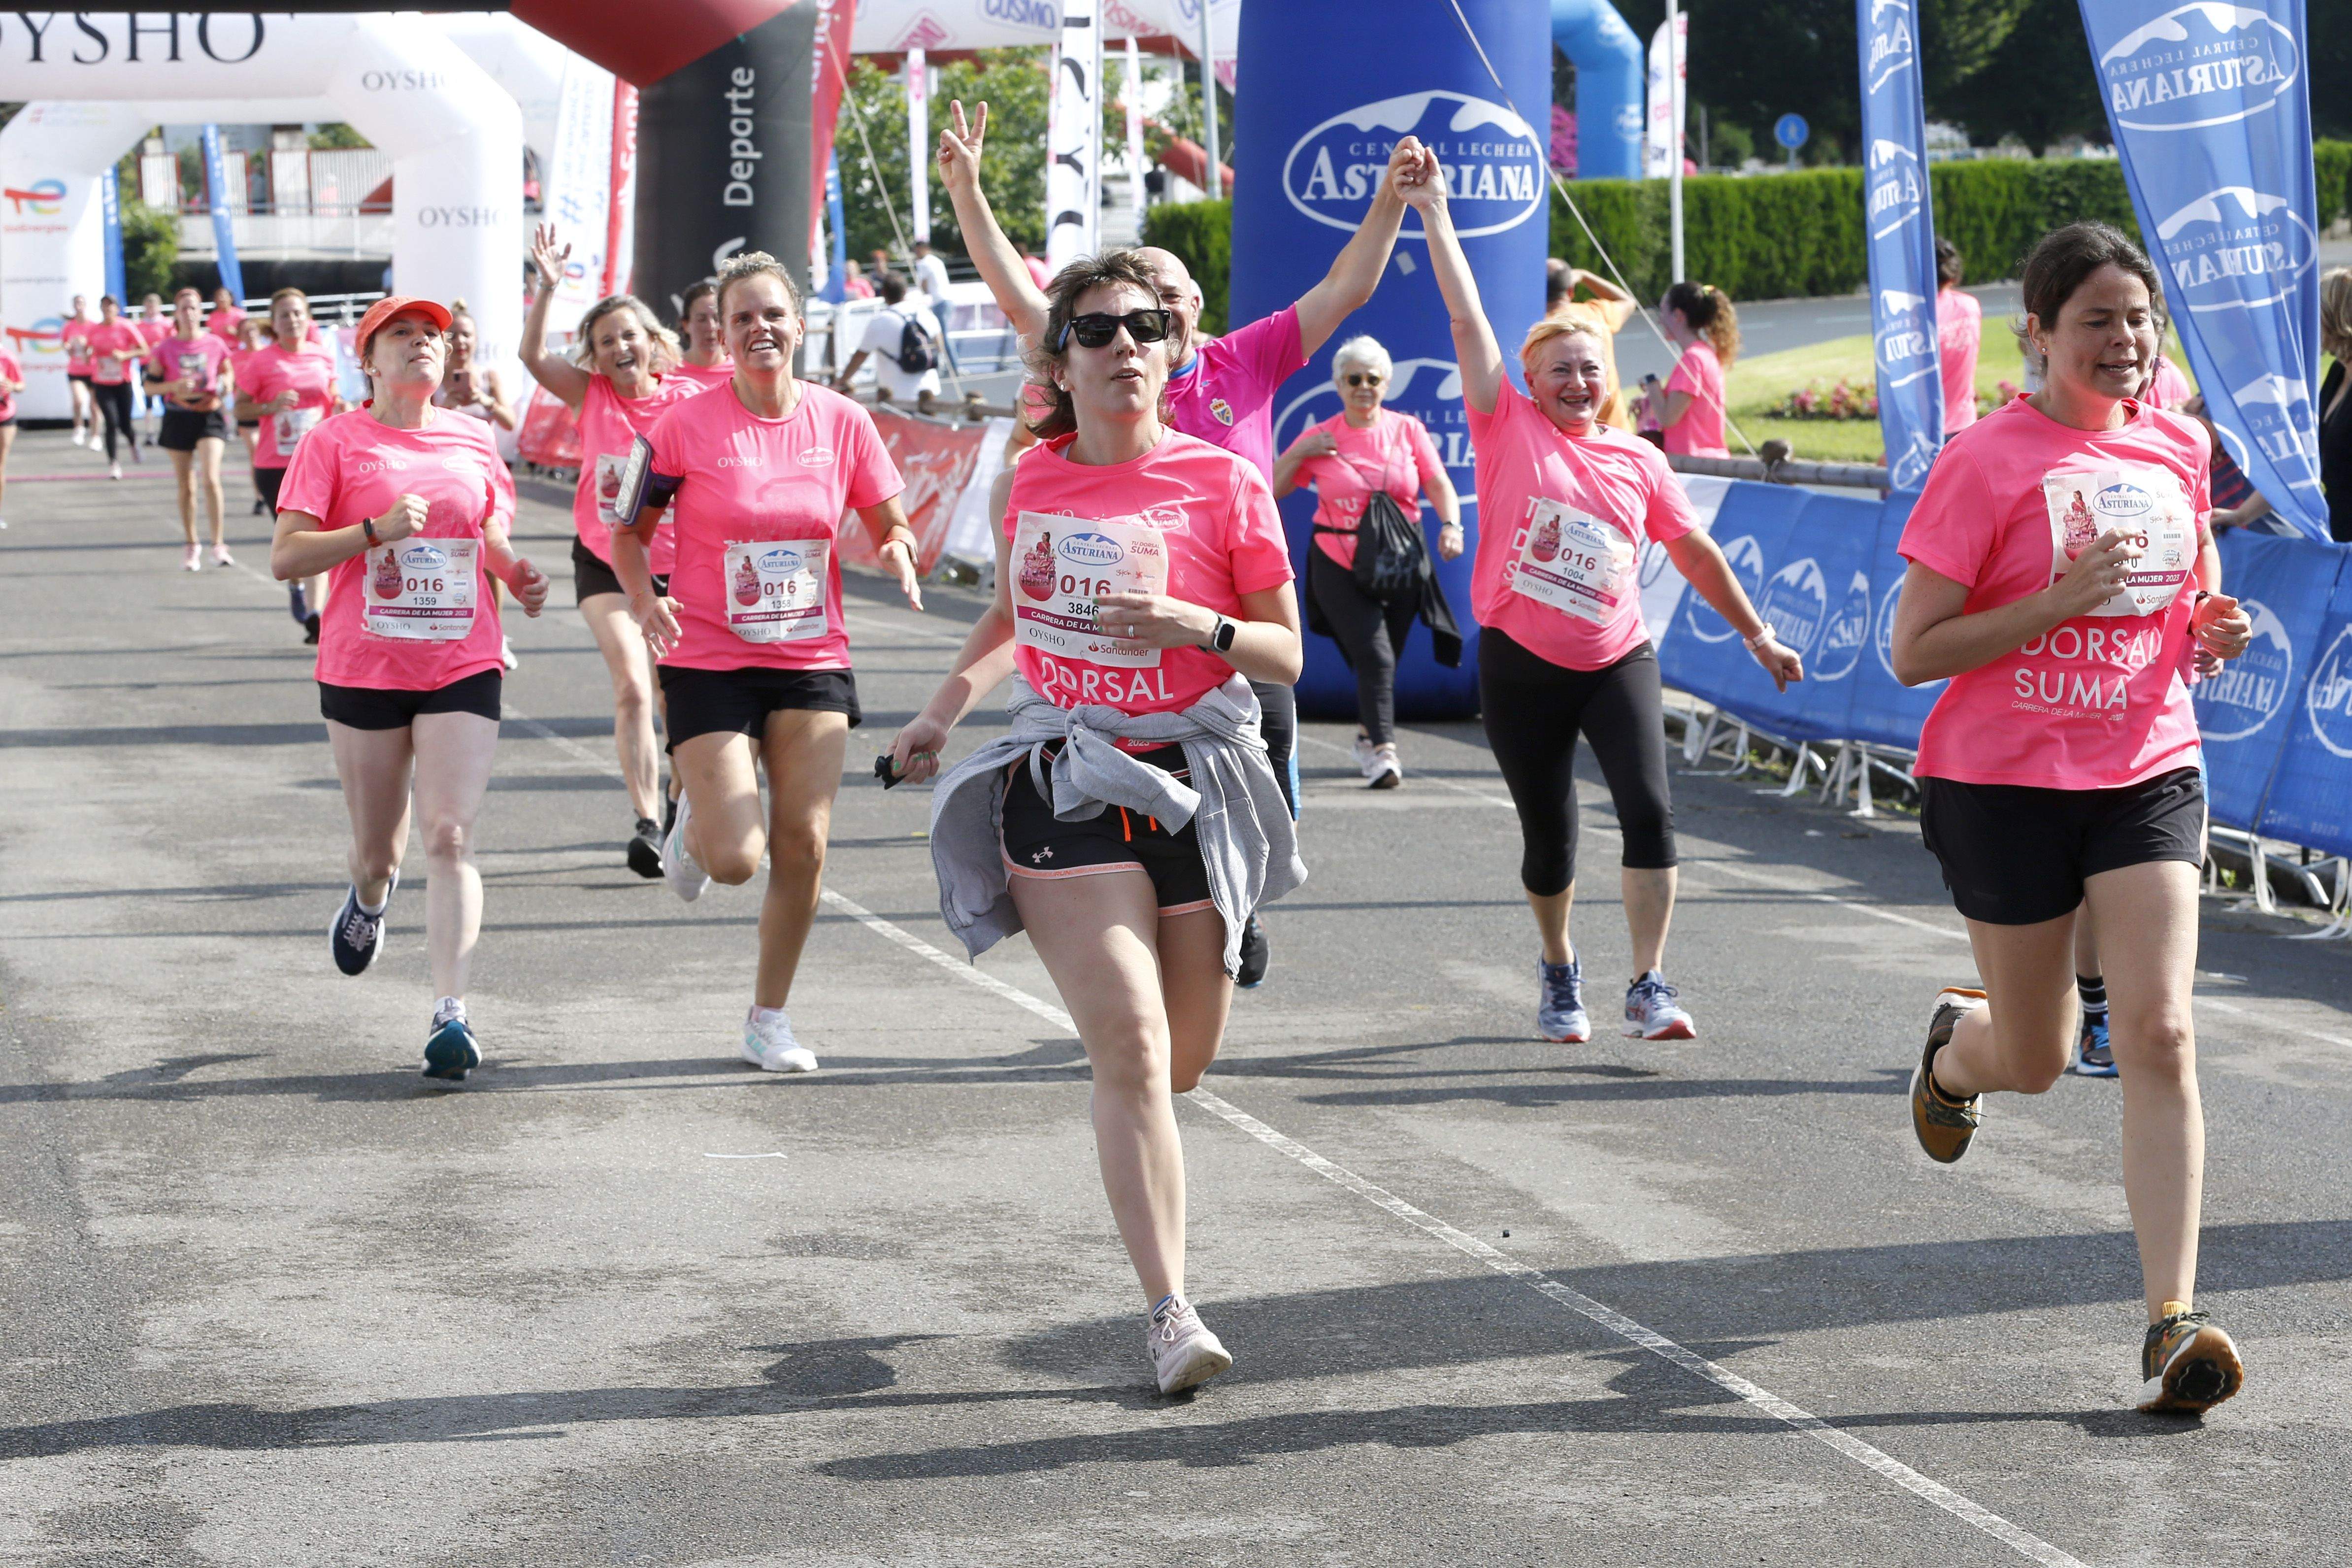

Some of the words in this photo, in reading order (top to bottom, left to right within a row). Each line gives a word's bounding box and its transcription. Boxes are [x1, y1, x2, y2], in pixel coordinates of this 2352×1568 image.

[0, 13, 265, 65] YSHO
[724, 66, 762, 206] Deporte
[1458, 142, 1531, 158] LECHERA
[1301, 145, 1534, 201] ASTRIANA
[359, 460, 406, 473] OYSHO
[718, 457, 762, 467] OYSHO
[2098, 496, 2149, 509] ASTURIANA
[1567, 525, 1606, 547] ASTURIANA
[1062, 541, 1119, 560] ASTURIANA
[1130, 546, 1159, 557] SUMA
[761, 560, 799, 568] ASTURIANA
[1561, 548, 1597, 570] 016
[1563, 567, 1585, 581] 1004
[2137, 575, 2163, 583] MUJER
[2165, 574, 2180, 582] 2023
[406, 578, 443, 592] 016
[764, 580, 796, 596] 016
[1060, 575, 1112, 597] 016
[1523, 579, 1553, 597] OYSHO
[413, 597, 436, 605] 1359
[771, 599, 791, 609] 1358
[1068, 602, 1099, 616] 3846
[376, 621, 411, 631] OYSHO
[1031, 611, 1064, 626] CARRERA
[1066, 620, 1078, 629] DE
[1079, 622, 1091, 631] LA
[739, 628, 771, 636] OYSHO
[1029, 627, 1065, 647] OYSHO
[2015, 668, 2127, 710] SUMA
[2011, 701, 2049, 714] CARRERA
[2051, 707, 2064, 716] DE
[2063, 709, 2074, 718] LA
